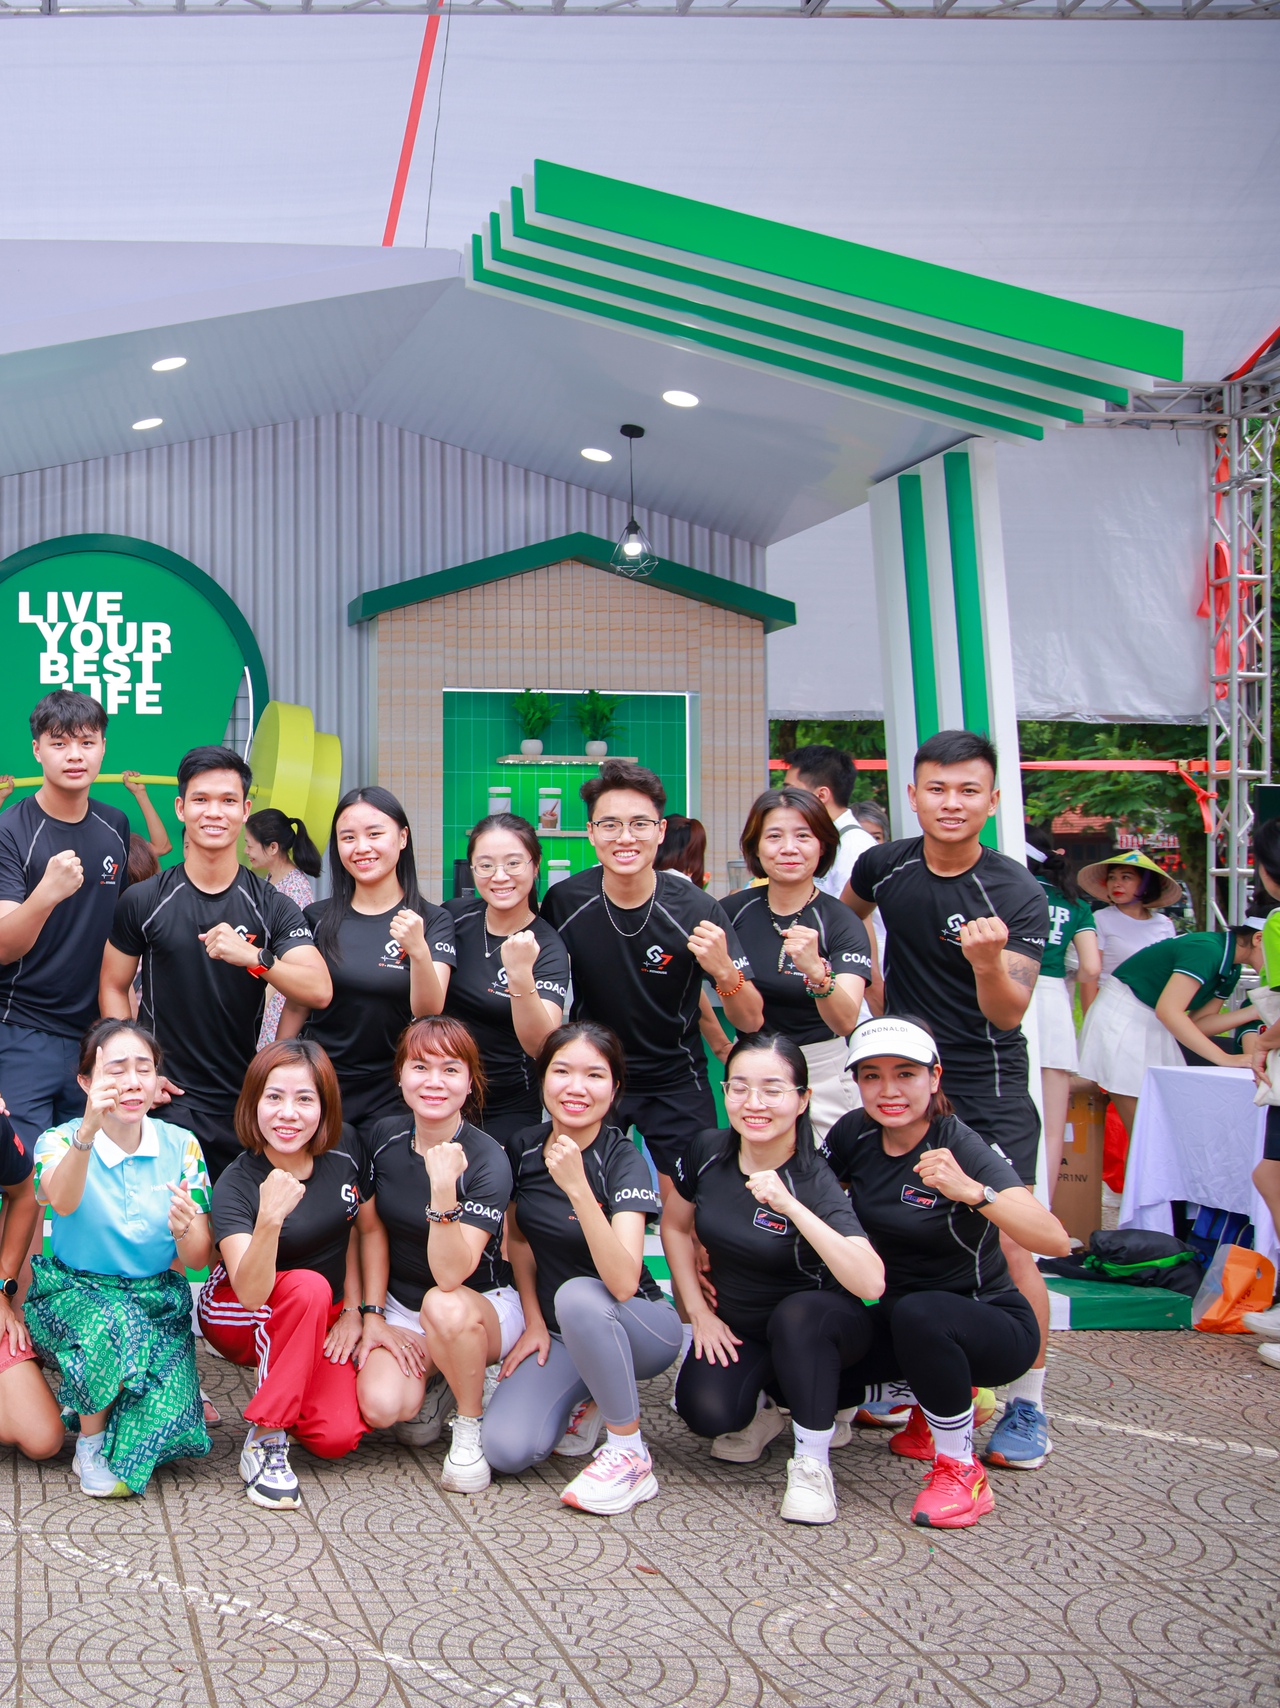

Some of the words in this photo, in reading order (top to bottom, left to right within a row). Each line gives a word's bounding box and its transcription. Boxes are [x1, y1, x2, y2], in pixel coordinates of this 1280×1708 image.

[18, 591, 123, 623] LIVE
[35, 621, 172, 654] YOUR
[39, 652, 162, 684] BEST
[62, 683, 162, 714] IFE
[615, 1188, 657, 1202] COACH
[464, 1200, 503, 1223] COACH
